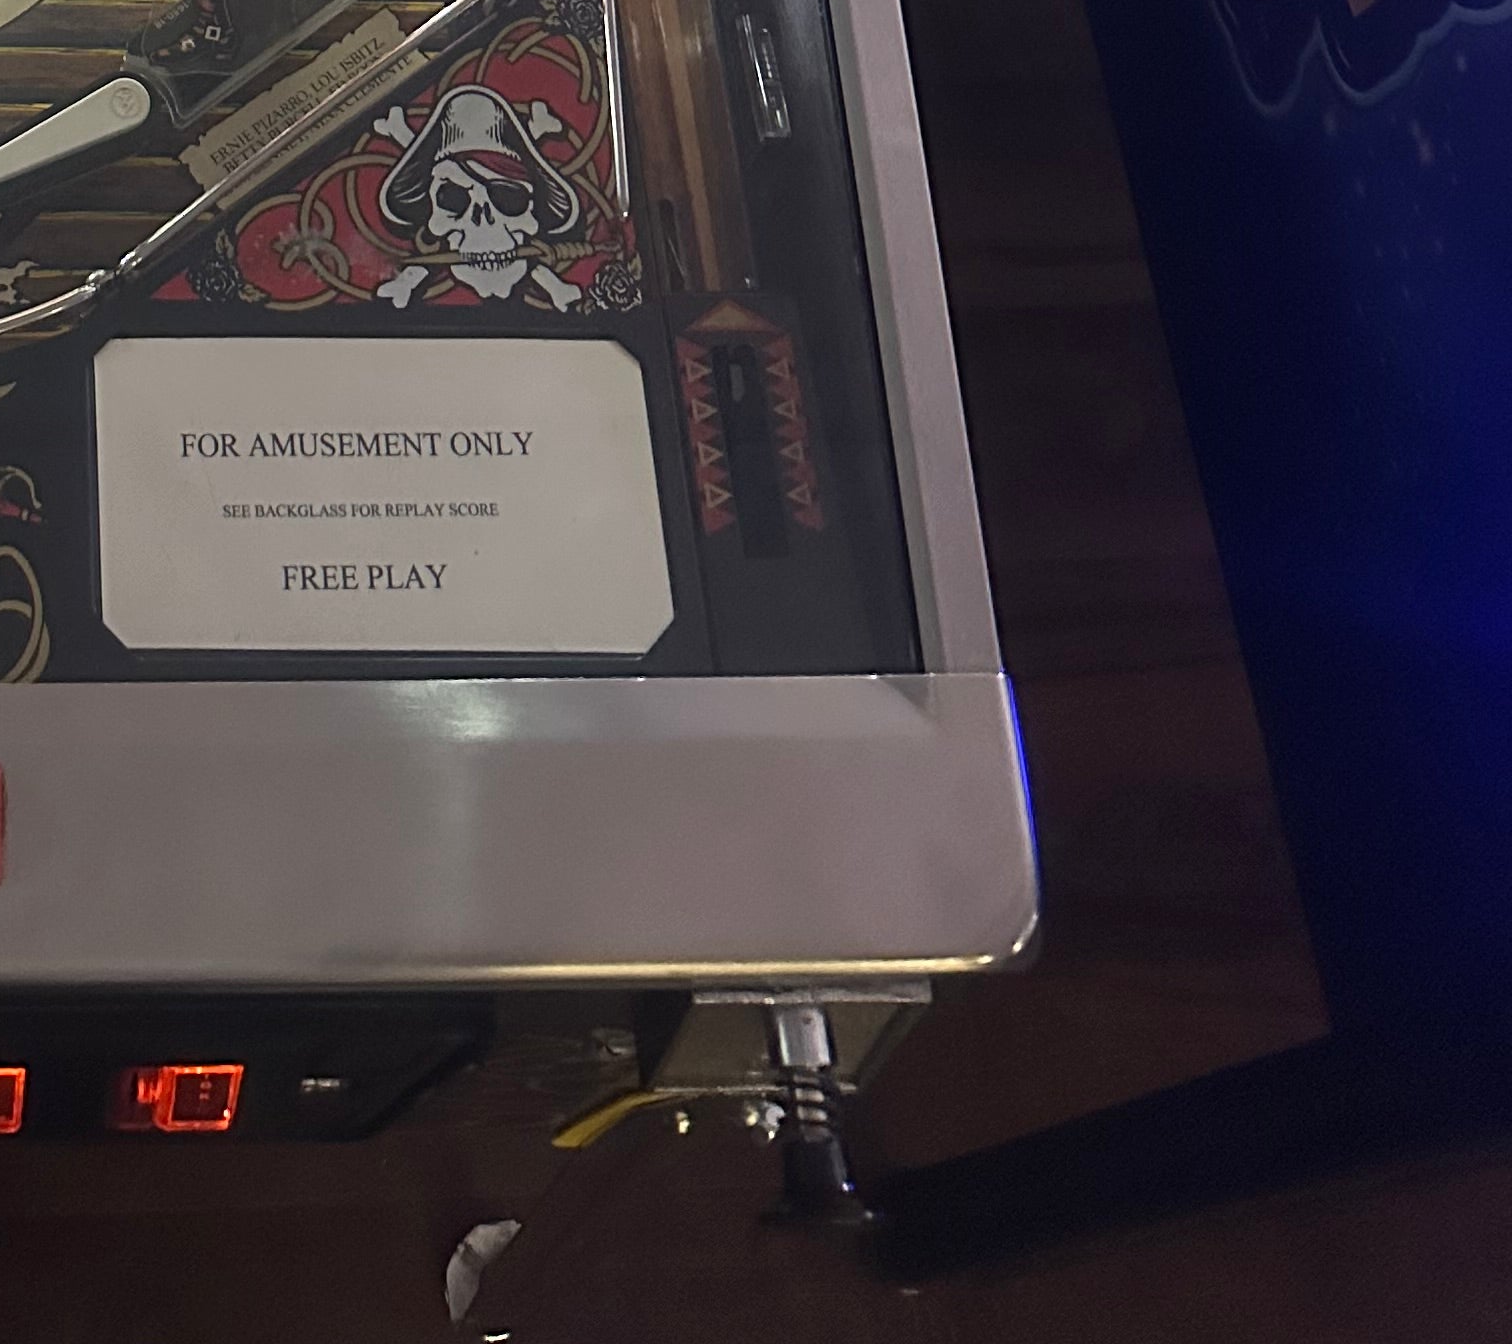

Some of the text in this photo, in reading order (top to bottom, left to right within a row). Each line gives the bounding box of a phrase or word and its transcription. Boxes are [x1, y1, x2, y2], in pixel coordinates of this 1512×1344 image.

[209, 129, 256, 166] ERNIE
[310, 69, 342, 94] LOU
[180, 430, 534, 458] FOR AMUSEMENT ONLY
[222, 502, 500, 519] SEE BACKGLASS FOR REPLAY SCORE
[281, 563, 448, 591] FREE PLAY
